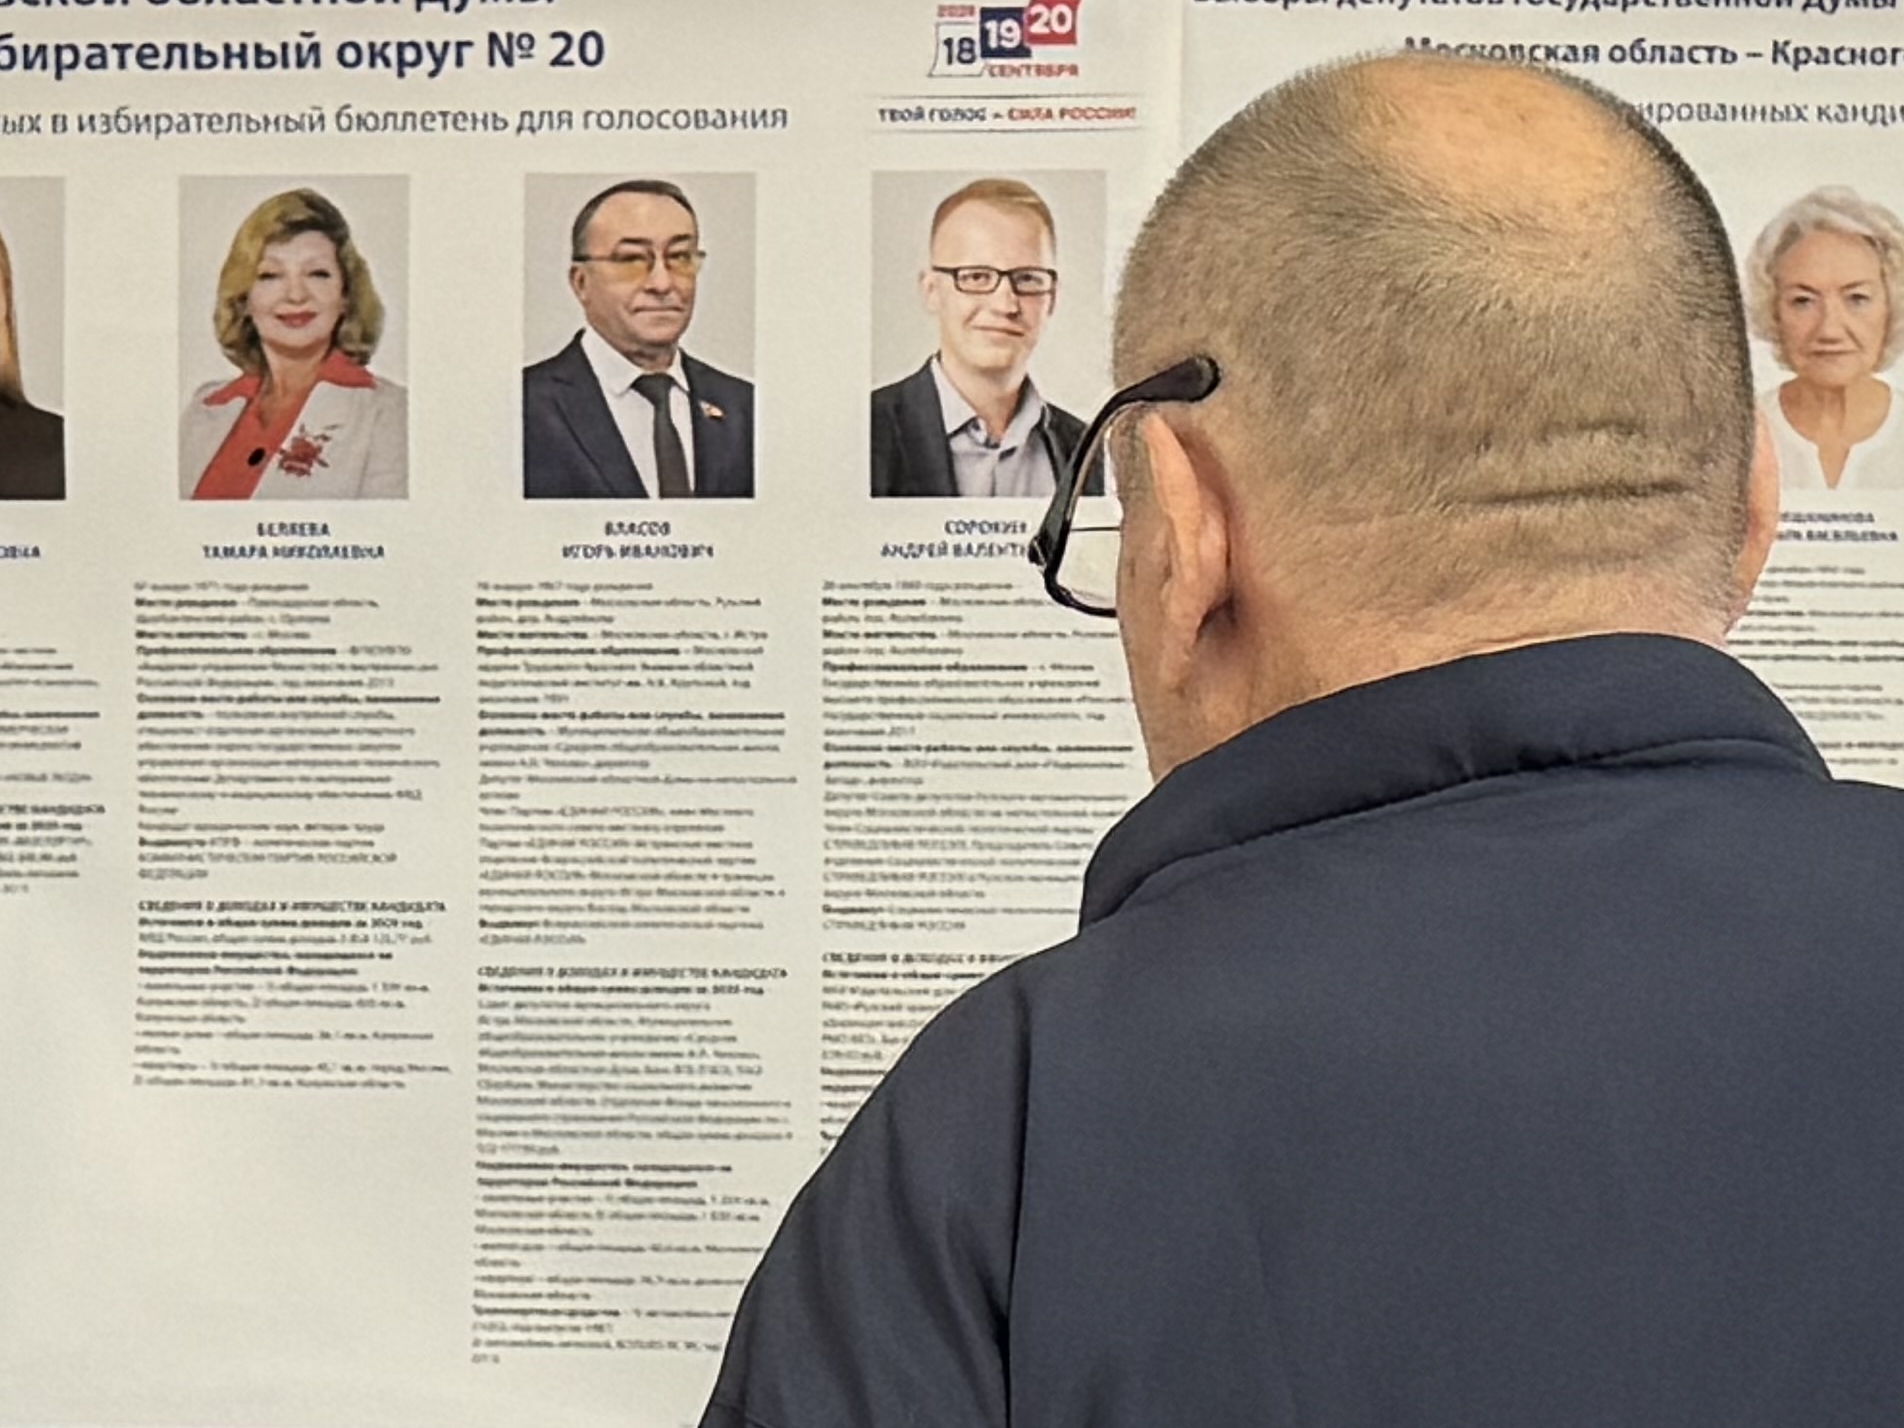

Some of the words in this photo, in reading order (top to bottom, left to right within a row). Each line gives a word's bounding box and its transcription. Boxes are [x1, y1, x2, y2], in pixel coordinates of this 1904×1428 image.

[984, 18, 1022, 49] 19
[1028, 3, 1073, 35] 20
[336, 38, 475, 79] округ
[487, 31, 536, 68] №
[548, 30, 605, 68] 20
[942, 37, 977, 65] 18
[1607, 37, 1738, 65] область
[50, 113, 69, 135] в
[77, 105, 326, 140] избирательный
[334, 103, 509, 134] бюллетень
[514, 109, 574, 137] для
[582, 108, 789, 132] голосования
